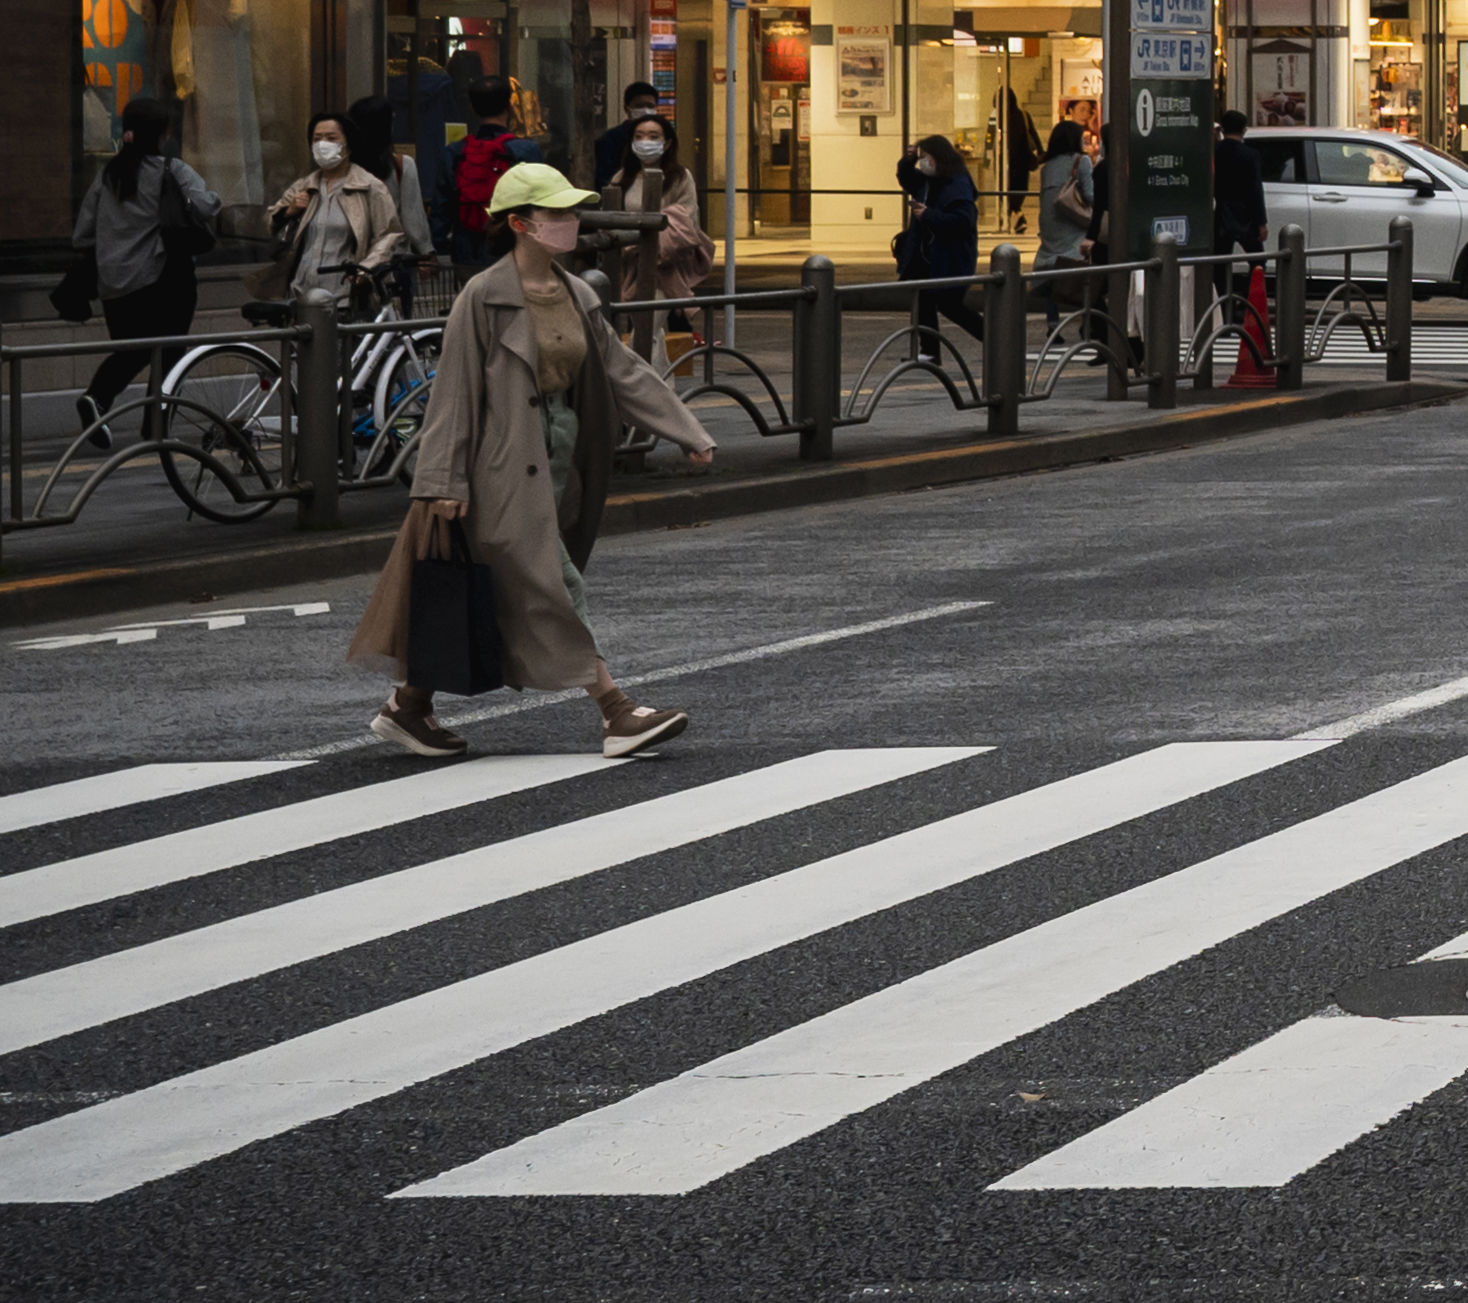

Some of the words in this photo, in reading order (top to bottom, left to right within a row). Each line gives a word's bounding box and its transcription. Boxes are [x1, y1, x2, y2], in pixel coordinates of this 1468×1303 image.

[1137, 39, 1150, 58] JR
[1153, 40, 1176, 58] 東京駅
